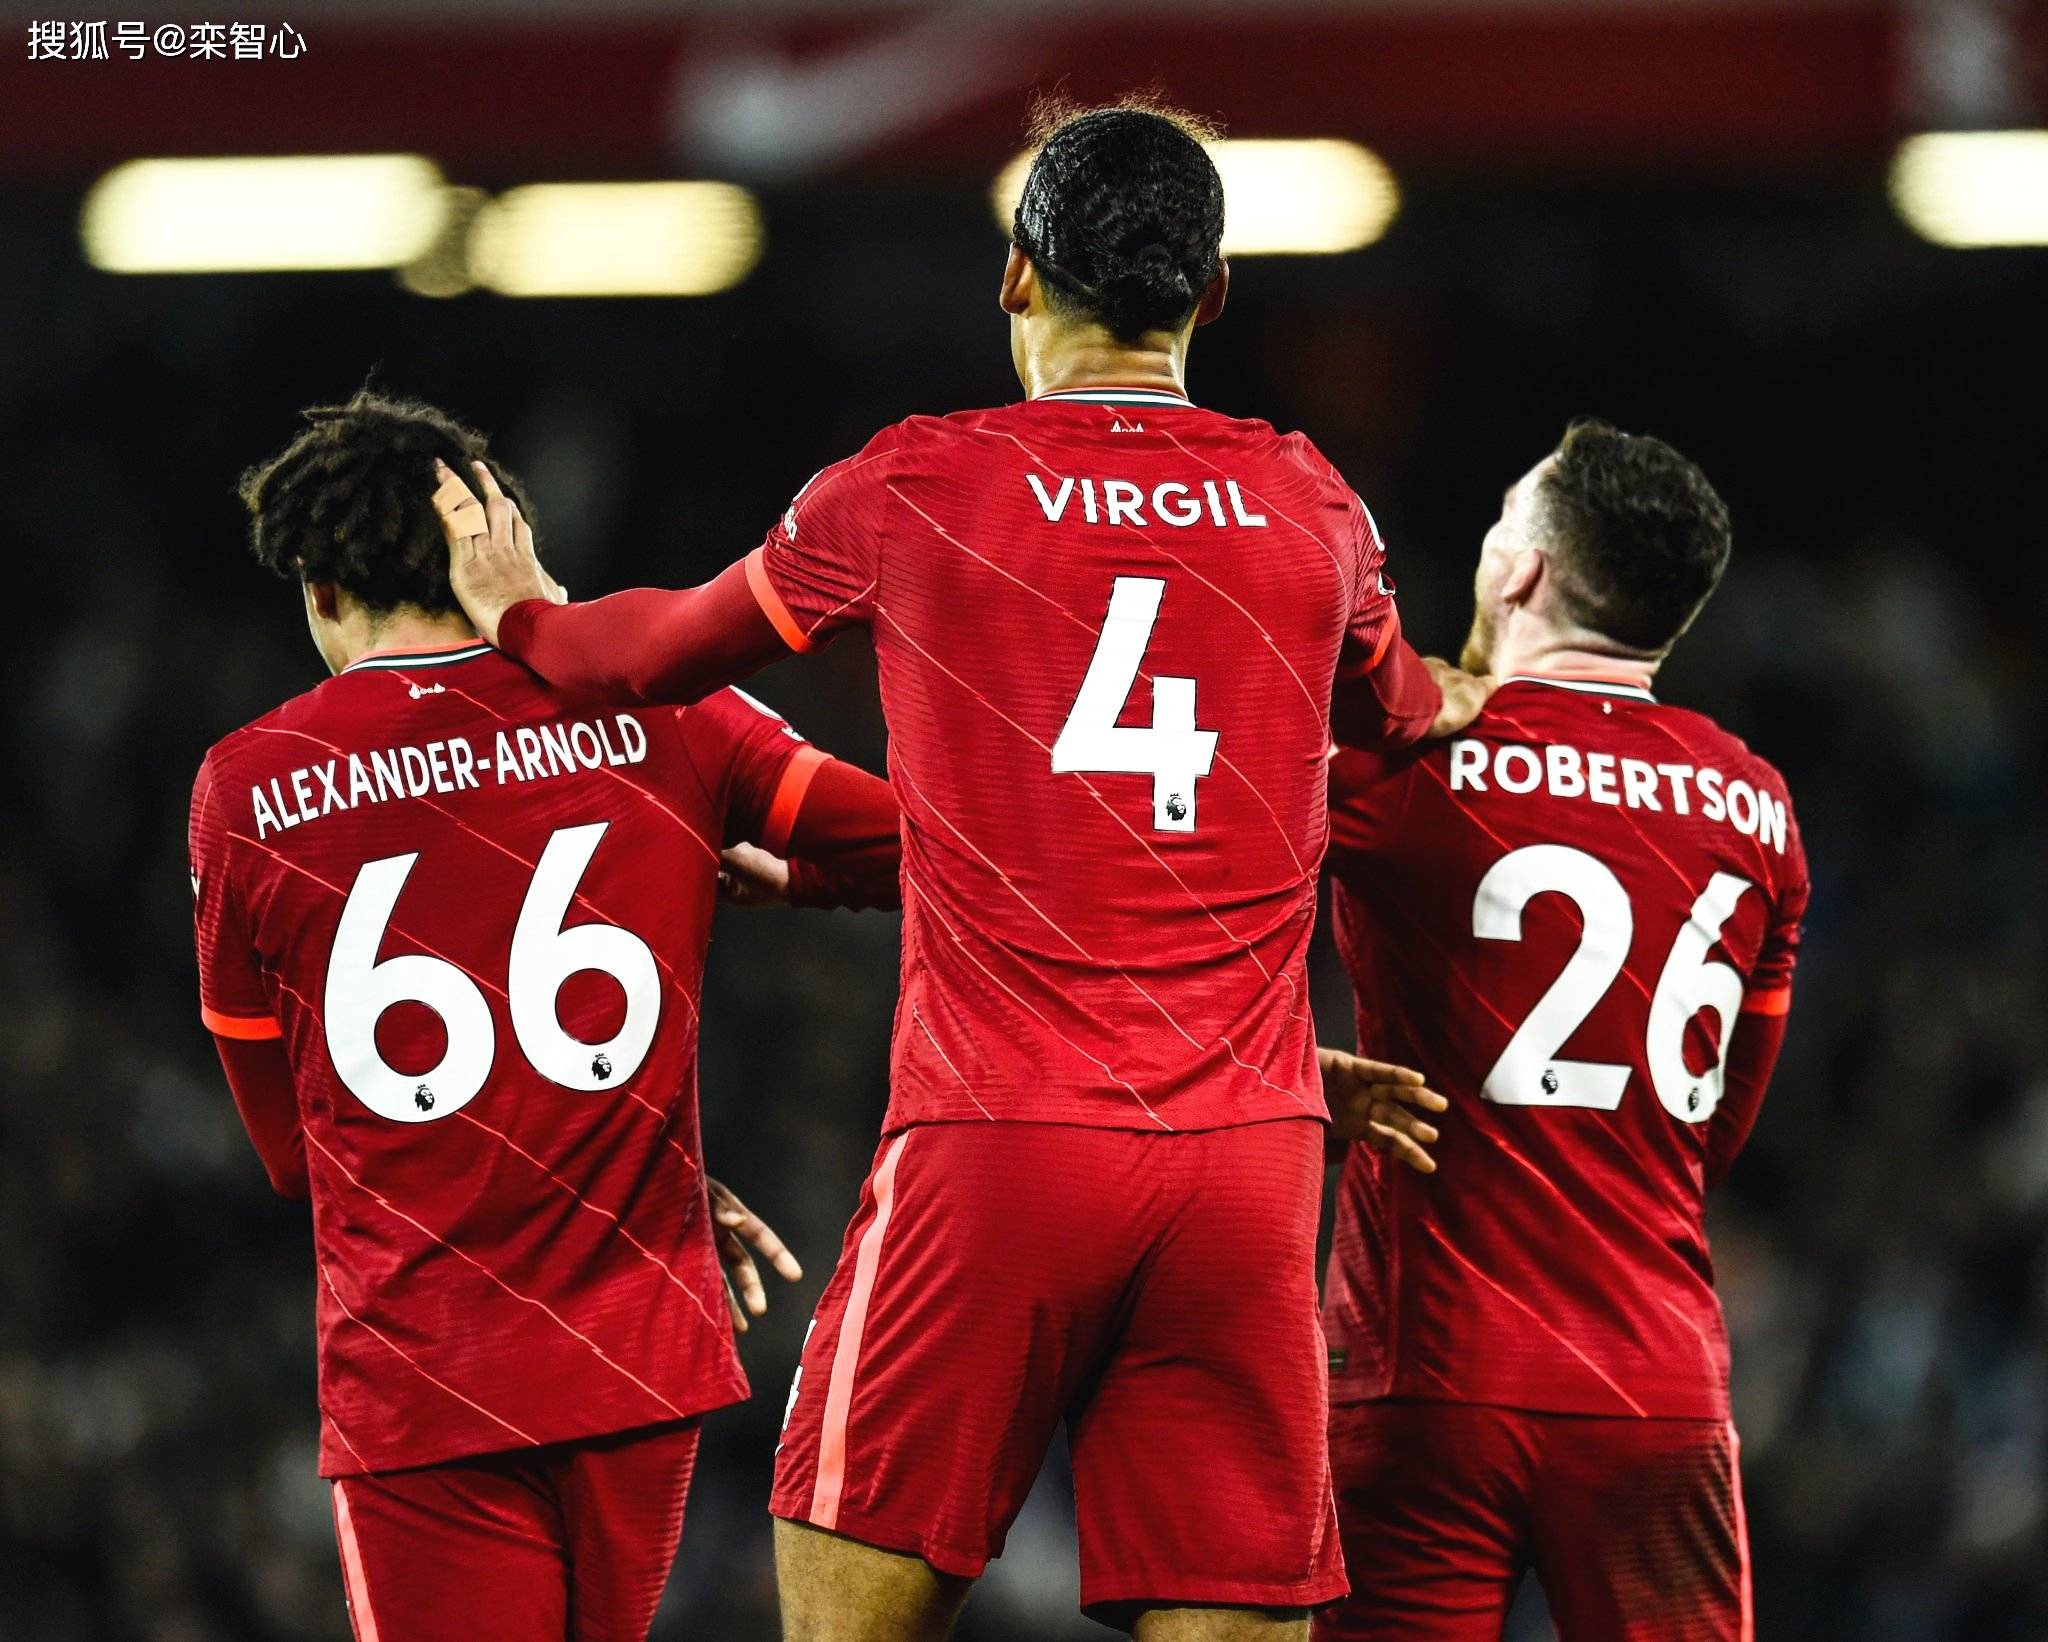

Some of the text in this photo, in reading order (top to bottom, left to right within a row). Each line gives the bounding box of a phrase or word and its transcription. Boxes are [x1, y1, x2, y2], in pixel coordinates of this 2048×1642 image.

[1025, 474, 1267, 528] VIRGIL
[251, 714, 647, 840] ALEXANDER-ARNOLD
[1049, 576, 1219, 832] 4
[1450, 739, 1788, 856] ROBERTSON
[324, 821, 660, 1123] 66
[1473, 843, 1753, 1124] 26
